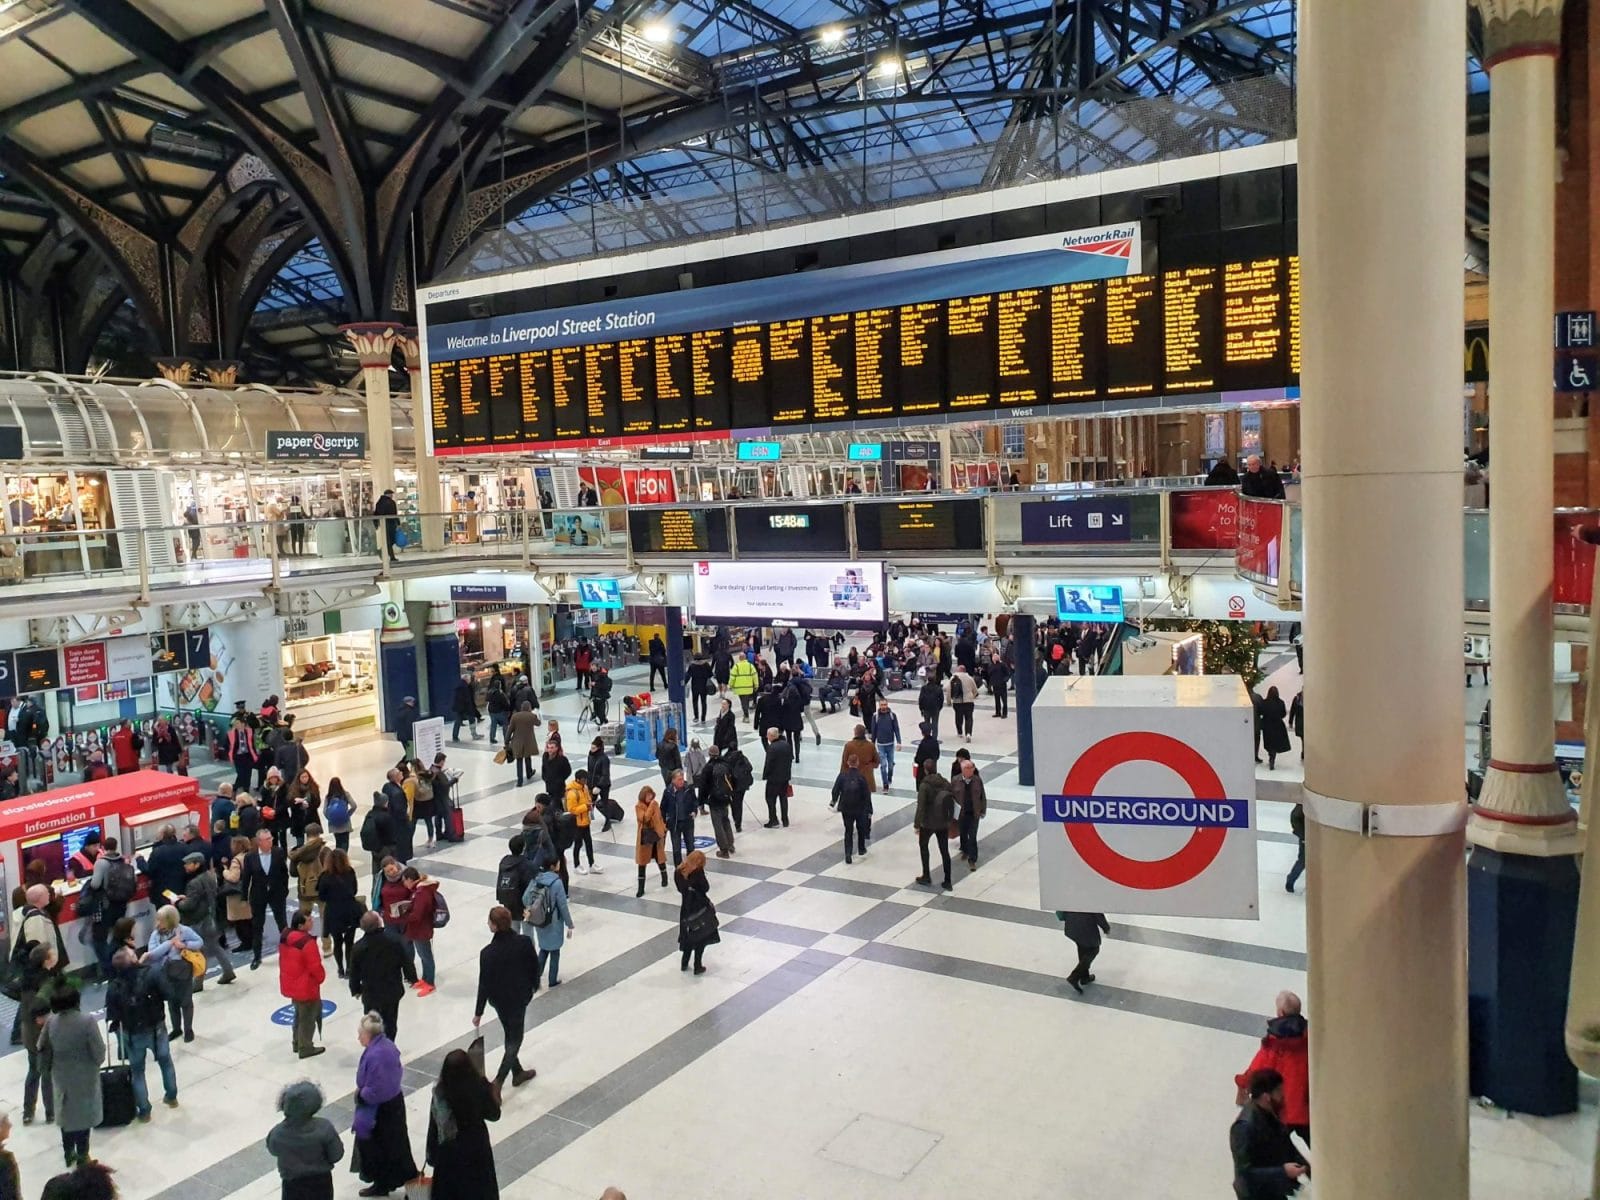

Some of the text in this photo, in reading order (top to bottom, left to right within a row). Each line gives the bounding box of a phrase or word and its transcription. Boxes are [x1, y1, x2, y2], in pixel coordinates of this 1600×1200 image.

[447, 310, 656, 350] Welcome to Liverpool Street Station
[1011, 408, 1033, 417] West
[598, 439, 611, 447] East
[634, 478, 667, 495] LEON
[1049, 514, 1072, 529] Lift
[192, 634, 204, 652] 7
[1055, 799, 1235, 823] UNDERGROUND
[25, 812, 86, 834] Information
